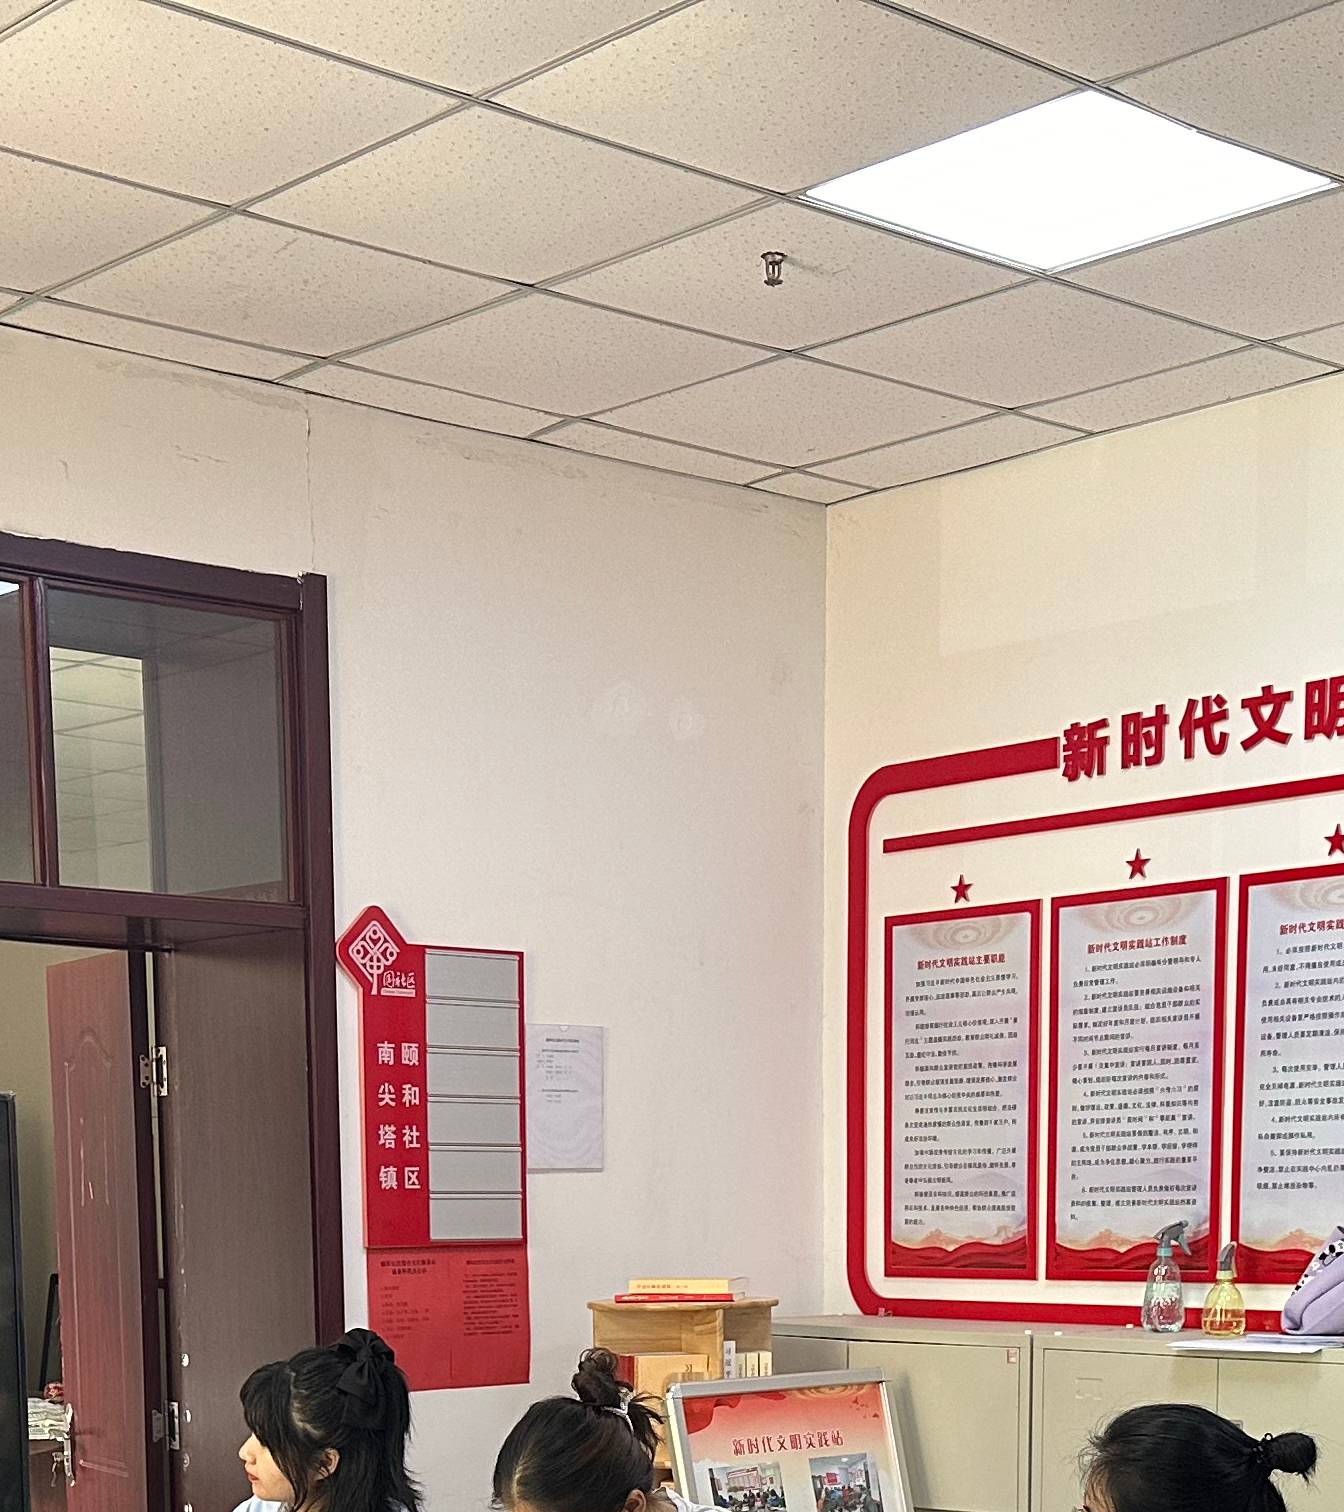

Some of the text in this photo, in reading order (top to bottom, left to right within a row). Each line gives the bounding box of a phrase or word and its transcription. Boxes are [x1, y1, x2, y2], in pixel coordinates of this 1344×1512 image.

[1087, 934, 1187, 954] 新时代文明实践站工作制度
[376, 1041, 398, 1190] 南尖塔镇
[401, 1042, 421, 1190] 颐和社区
[732, 1429, 844, 1456] 新时代文明实践站
